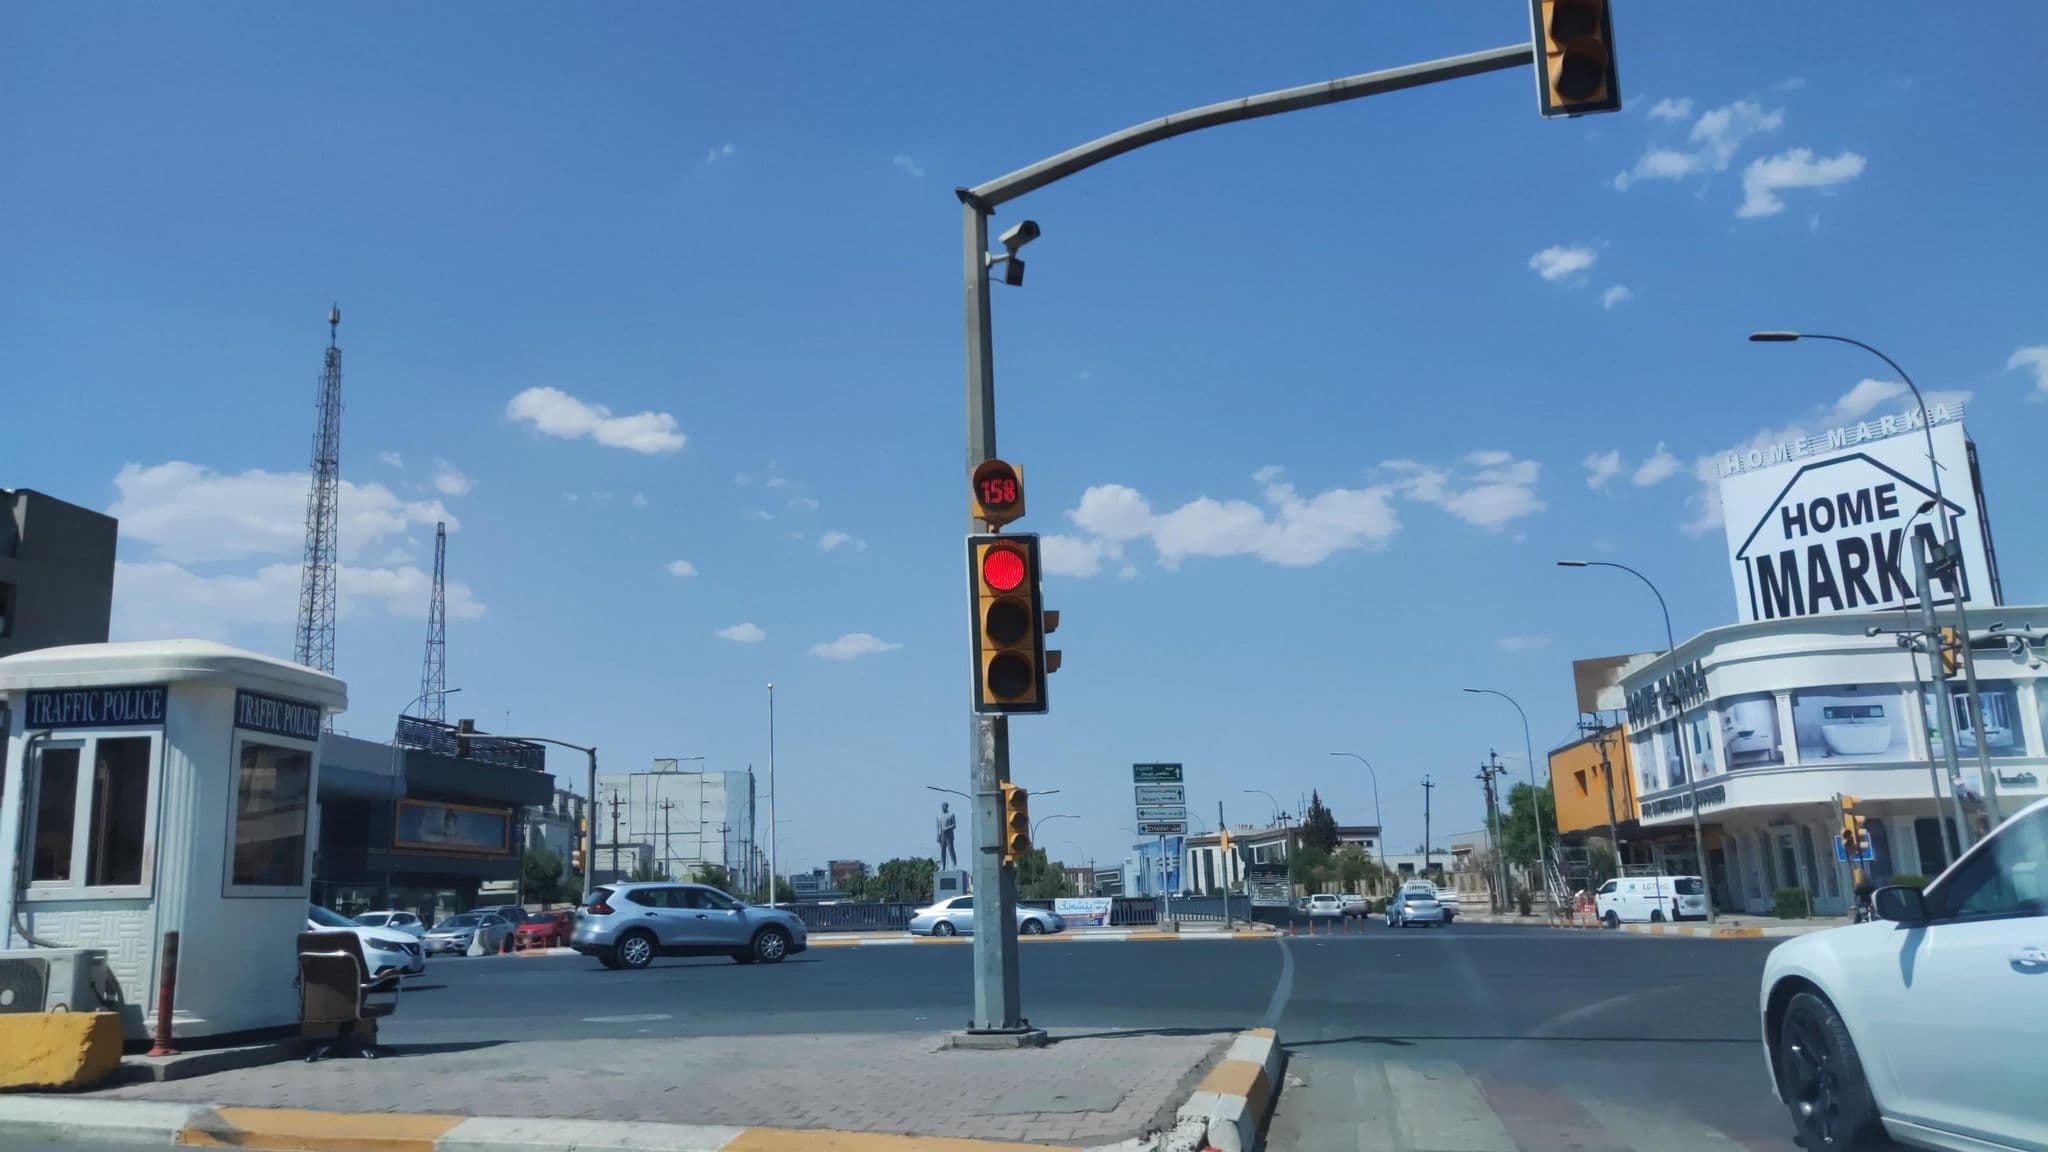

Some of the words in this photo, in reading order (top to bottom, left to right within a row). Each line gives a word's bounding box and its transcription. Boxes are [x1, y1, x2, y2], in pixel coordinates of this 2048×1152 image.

[1724, 436, 1810, 476] HOME
[1828, 402, 1951, 449] MARKA
[981, 479, 1016, 504] 158
[1781, 482, 1899, 539] HOME
[1756, 522, 1957, 620] MARKA
[32, 691, 99, 723] TRAFFIC
[102, 689, 162, 721] POLICE
[240, 694, 282, 730] TRAFFIC
[282, 704, 318, 736] POLICE
